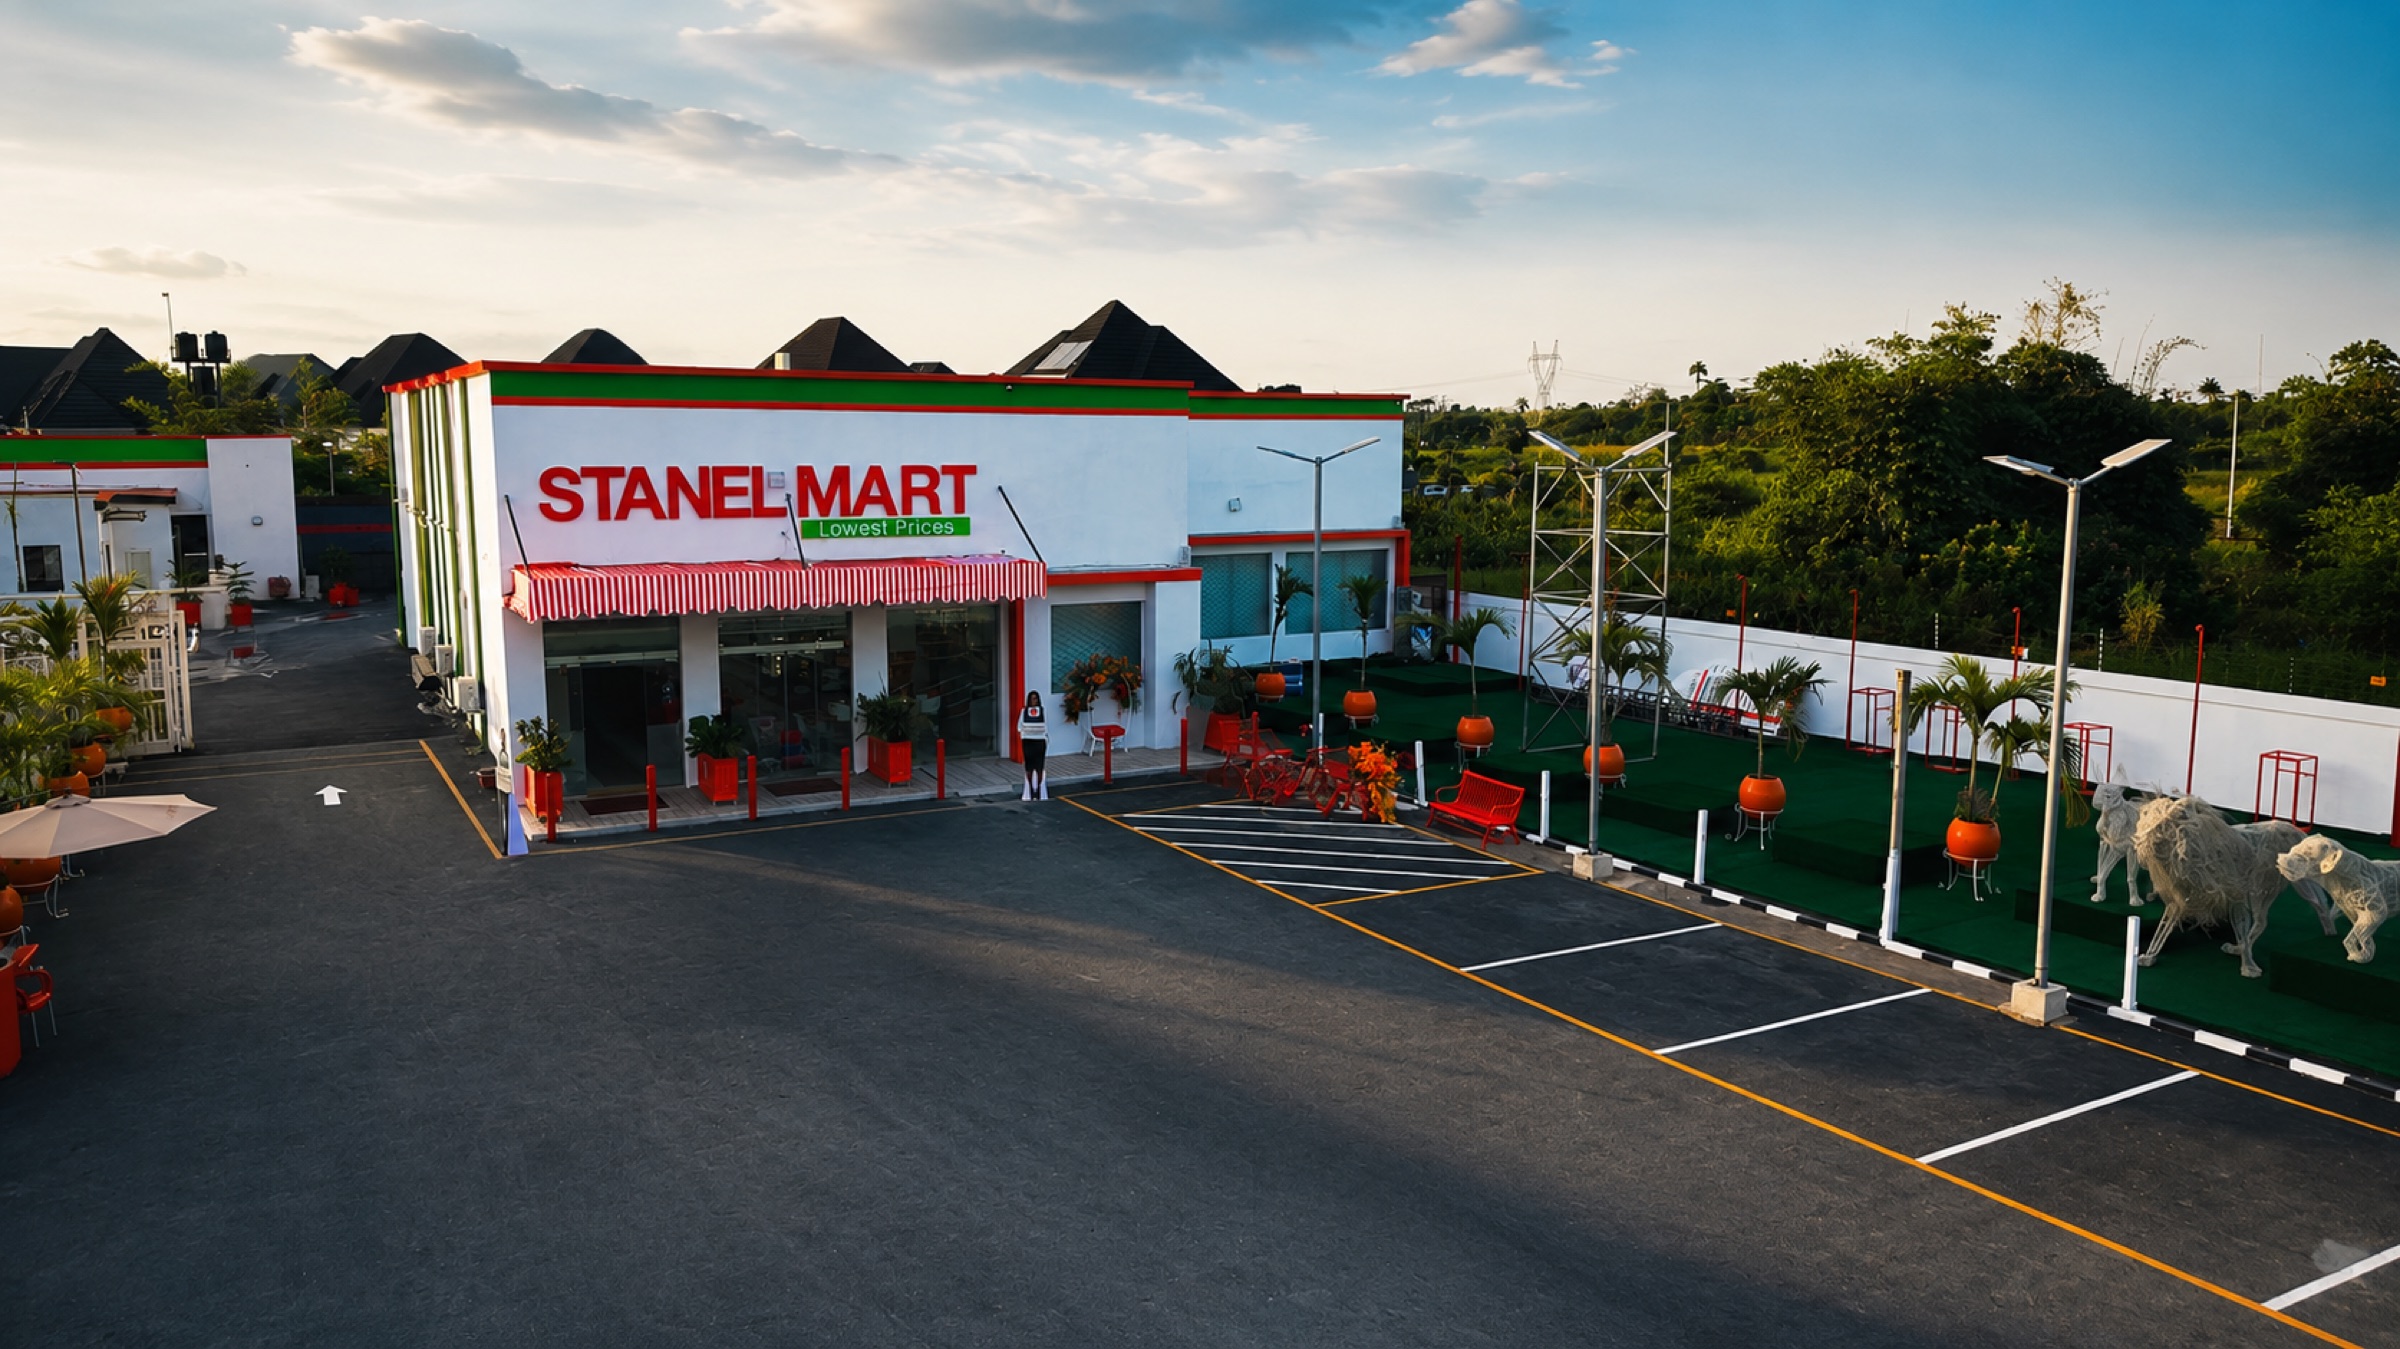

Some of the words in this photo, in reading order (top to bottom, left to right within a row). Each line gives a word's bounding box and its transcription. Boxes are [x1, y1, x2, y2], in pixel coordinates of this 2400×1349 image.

[539, 465, 787, 523] STANEL
[796, 464, 978, 518] MART
[819, 520, 888, 538] Lowest
[895, 518, 955, 536] Prices
